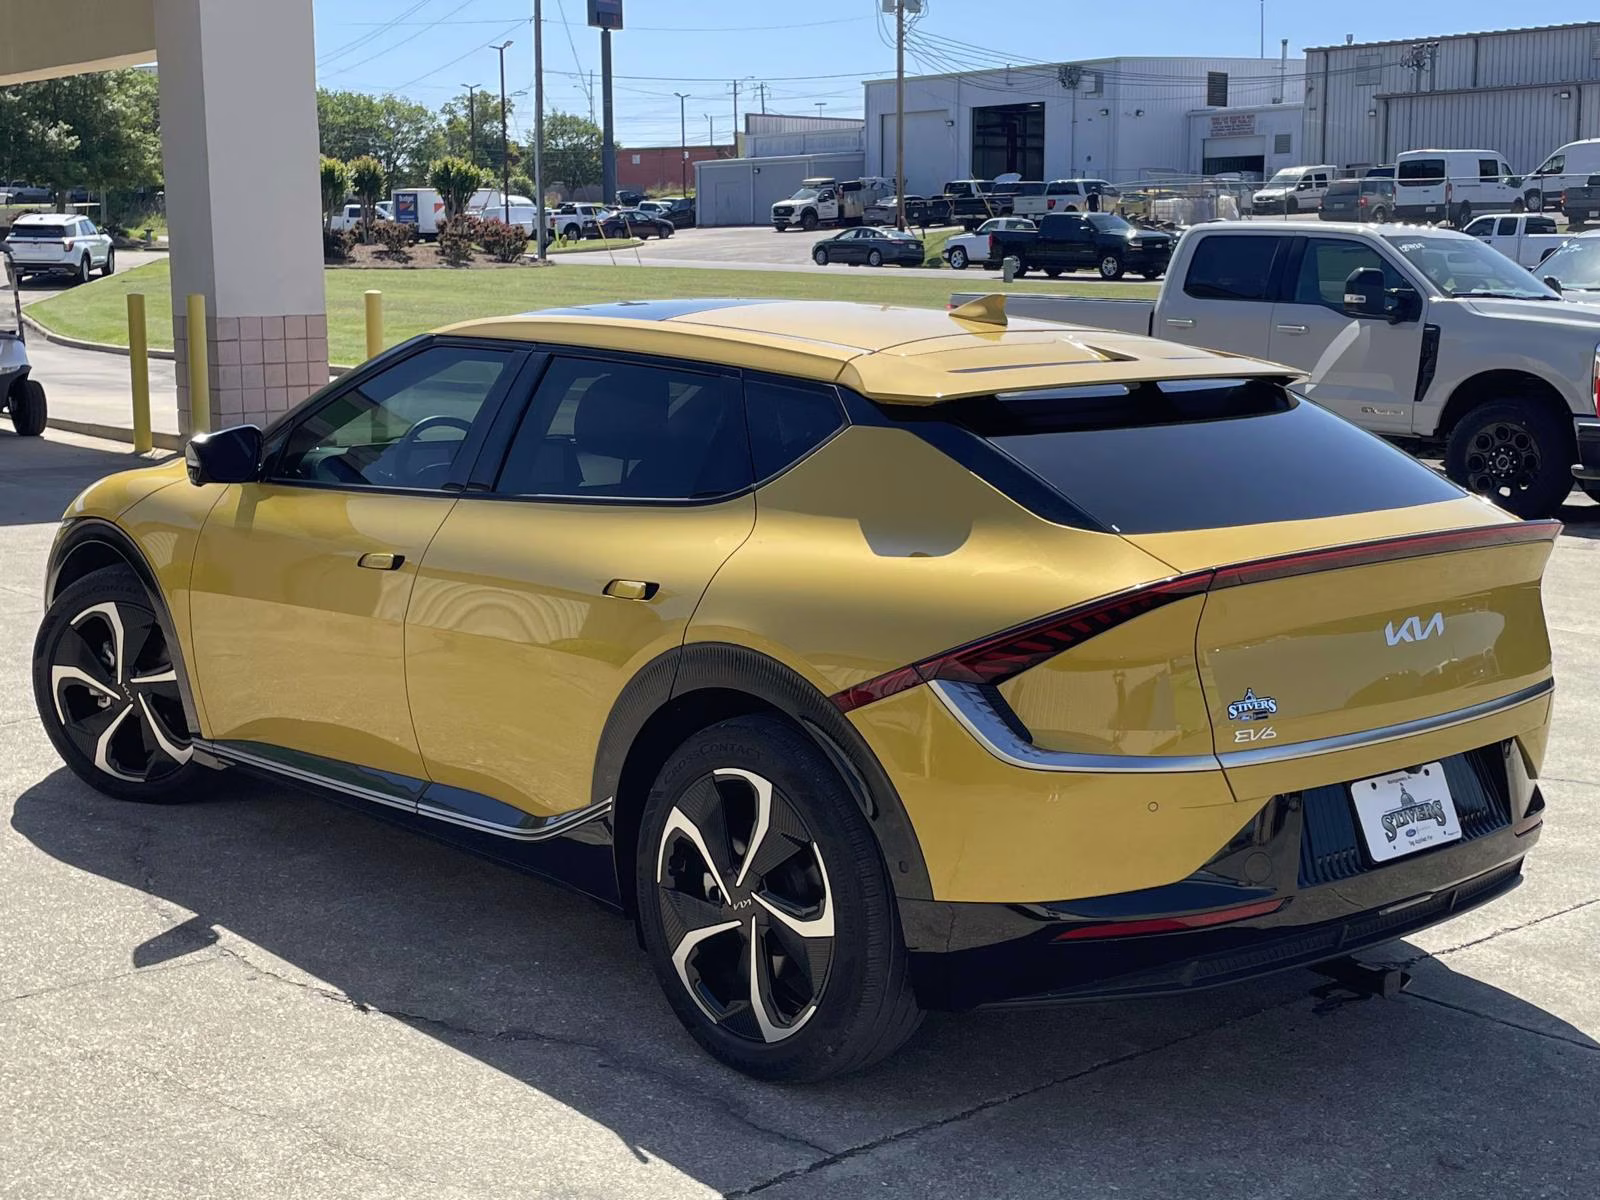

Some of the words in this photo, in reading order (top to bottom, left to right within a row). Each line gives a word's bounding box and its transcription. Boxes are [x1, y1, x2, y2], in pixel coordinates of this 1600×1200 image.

[1385, 612, 1444, 646] KIA
[1228, 699, 1277, 719] STIVERS
[1234, 727, 1277, 743] EV6
[1381, 800, 1446, 843] STIVERS
